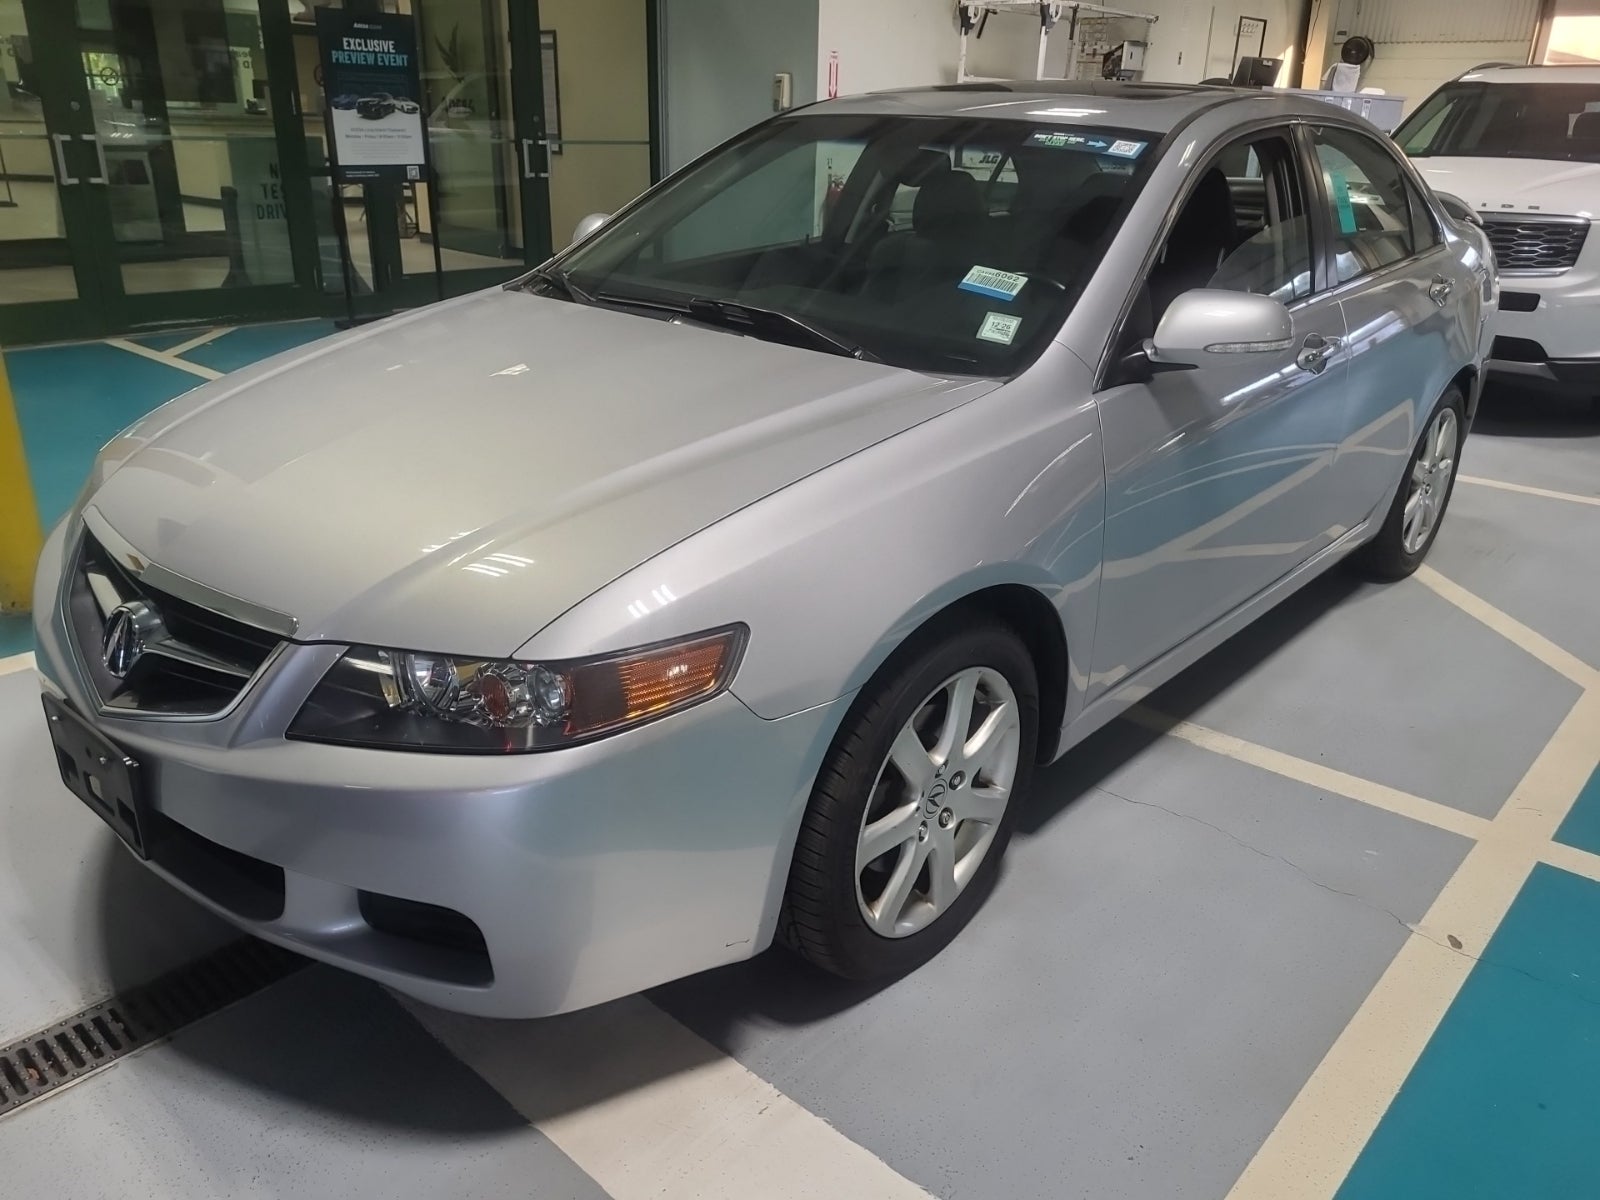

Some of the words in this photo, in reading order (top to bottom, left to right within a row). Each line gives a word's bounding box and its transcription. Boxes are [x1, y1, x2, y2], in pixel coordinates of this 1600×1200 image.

[342, 37, 396, 53] EXCLUSIVE
[331, 50, 375, 65] PREVIEW
[377, 53, 408, 67] EVENT
[979, 155, 999, 164] JLG
[261, 183, 287, 201] TES
[256, 204, 288, 220] DRIV
